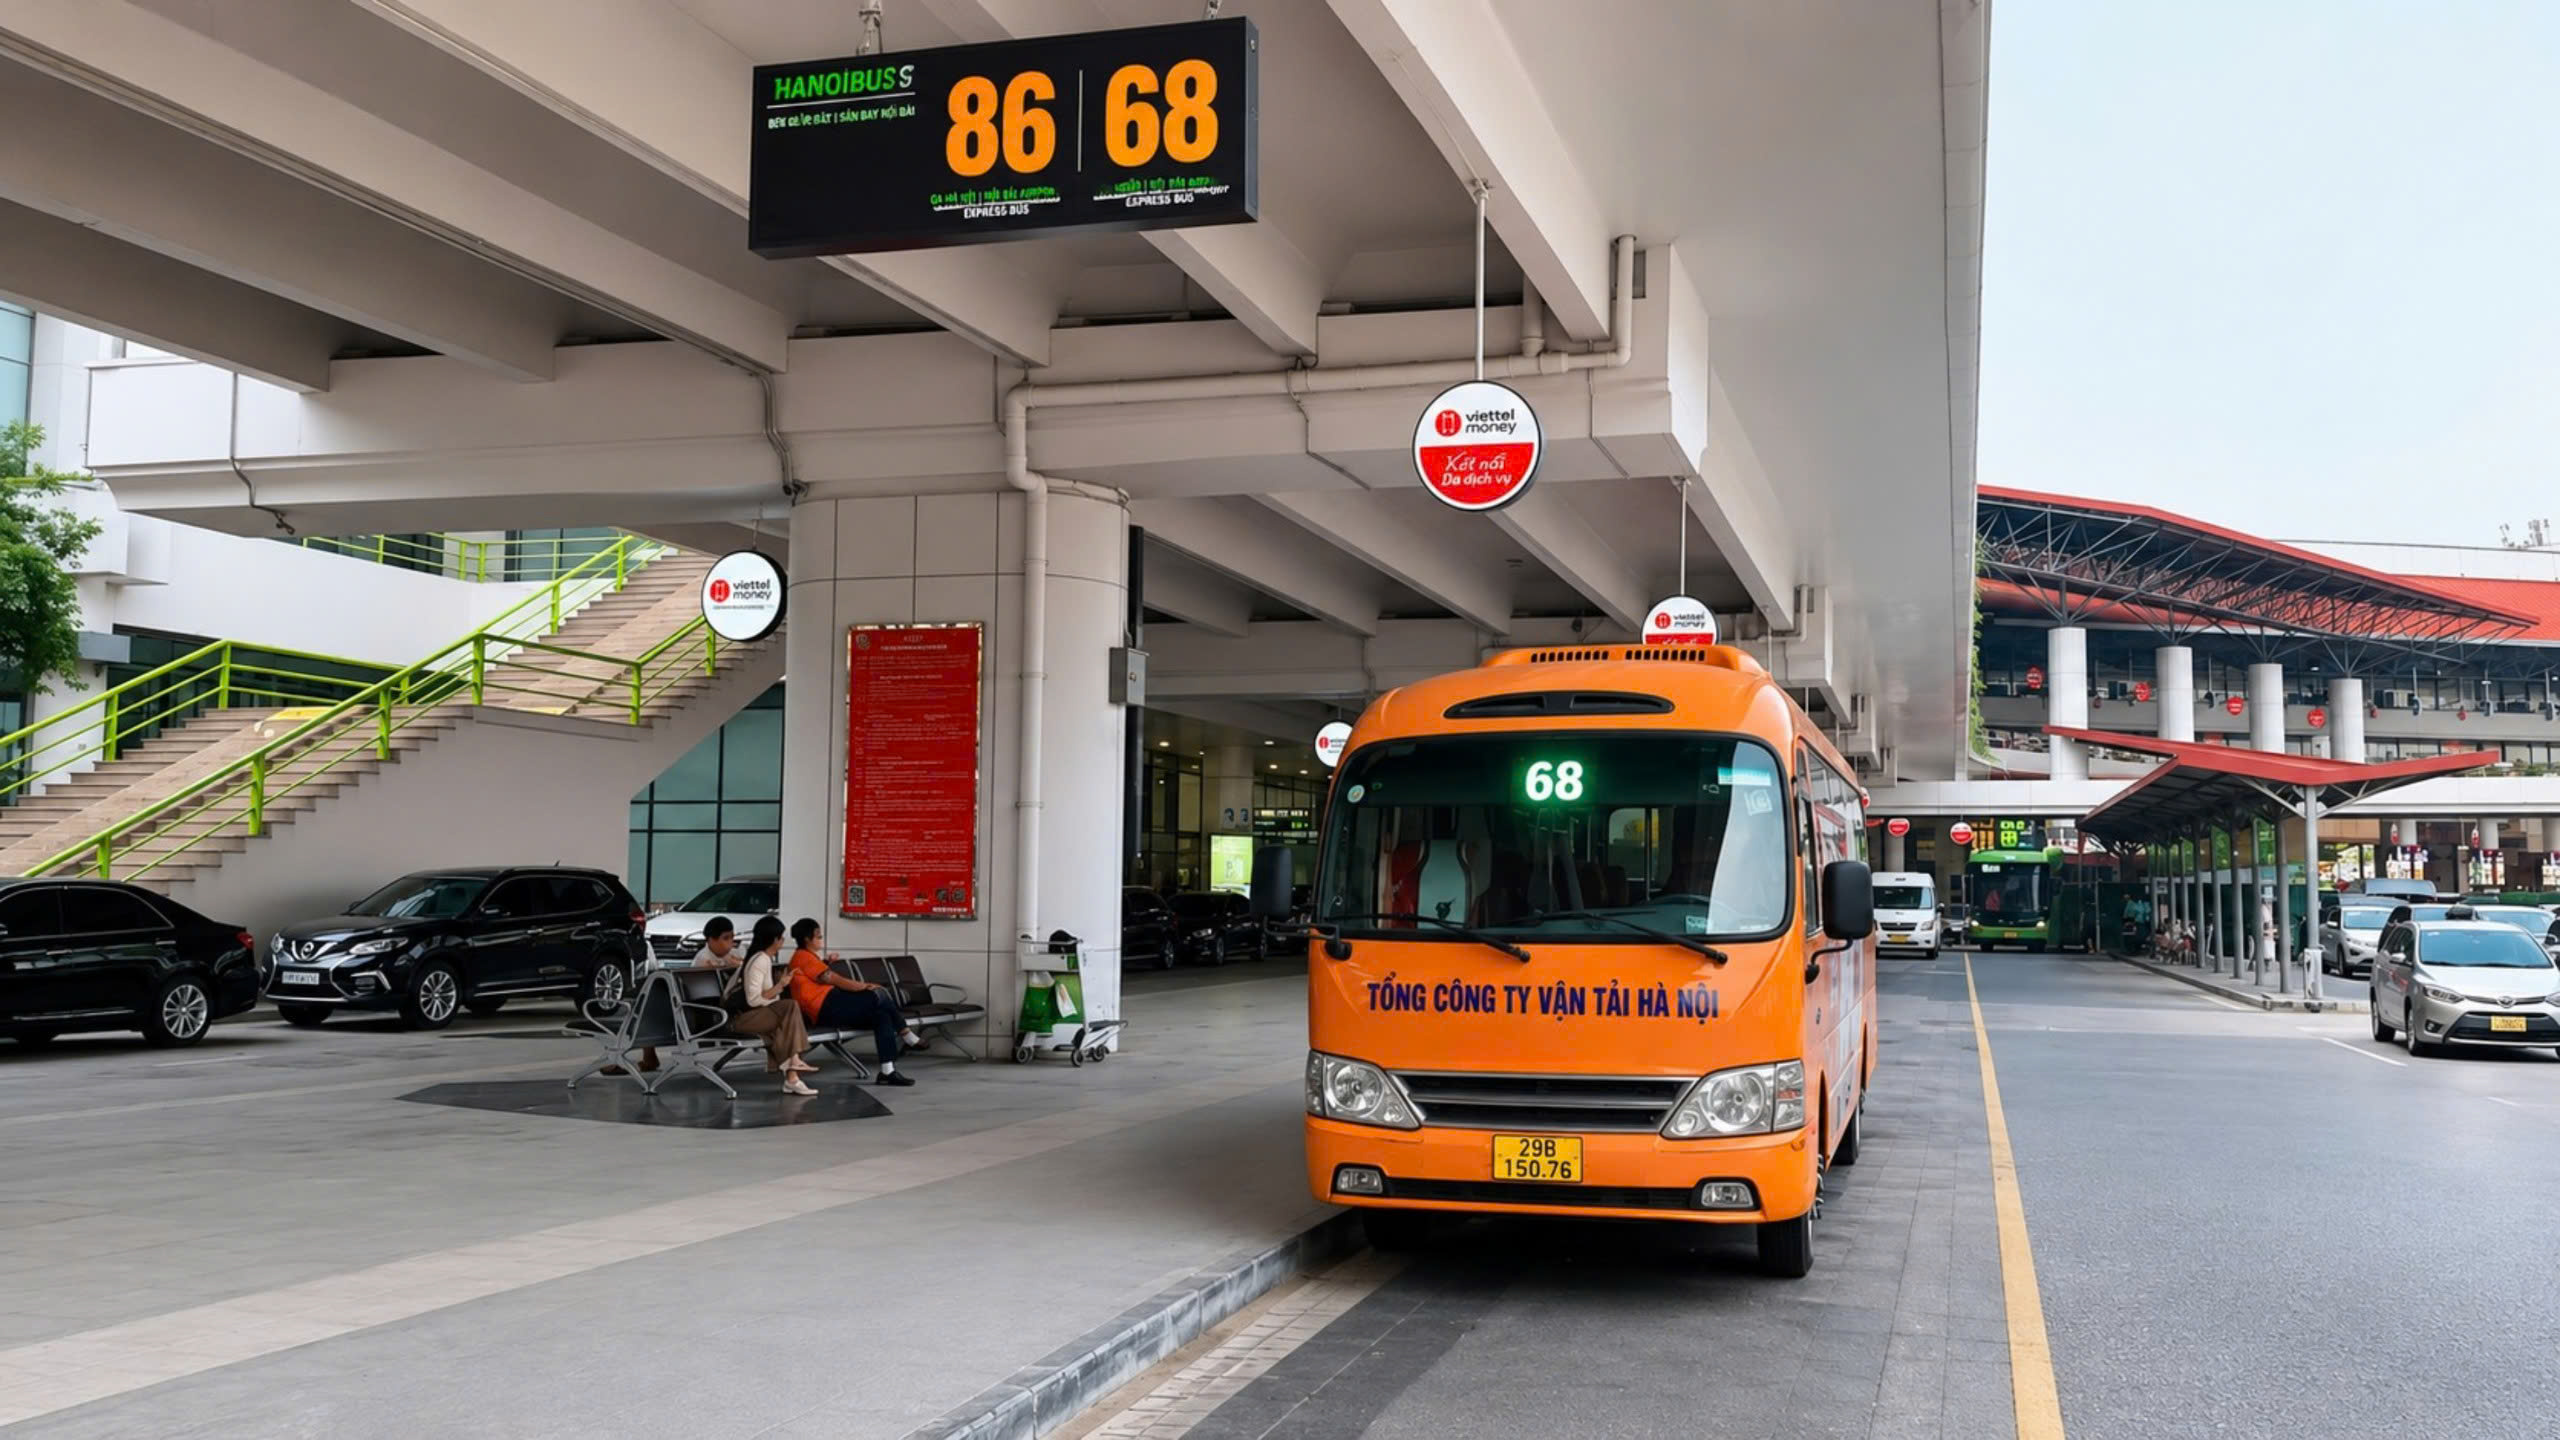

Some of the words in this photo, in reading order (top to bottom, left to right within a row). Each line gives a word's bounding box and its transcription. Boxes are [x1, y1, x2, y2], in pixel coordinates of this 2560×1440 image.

[1105, 59, 1218, 167] 68
[946, 71, 1056, 177] 86
[1466, 409, 1515, 422] viettel
[1466, 422, 1517, 435] money
[733, 591, 772, 600] money
[1525, 761, 1584, 802] 68
[1367, 971, 1426, 1012] TỔNG
[1434, 978, 1496, 1014] CÔNG
[1503, 985, 1532, 1015] TY
[1537, 981, 1586, 1022] VẬN
[1593, 979, 1630, 1017] TẢI
[1637, 983, 1670, 1018] HÀ
[1677, 983, 1719, 1025] NỘI
[1519, 1138, 1556, 1158] 29B
[1504, 1158, 1572, 1179] 150.76
